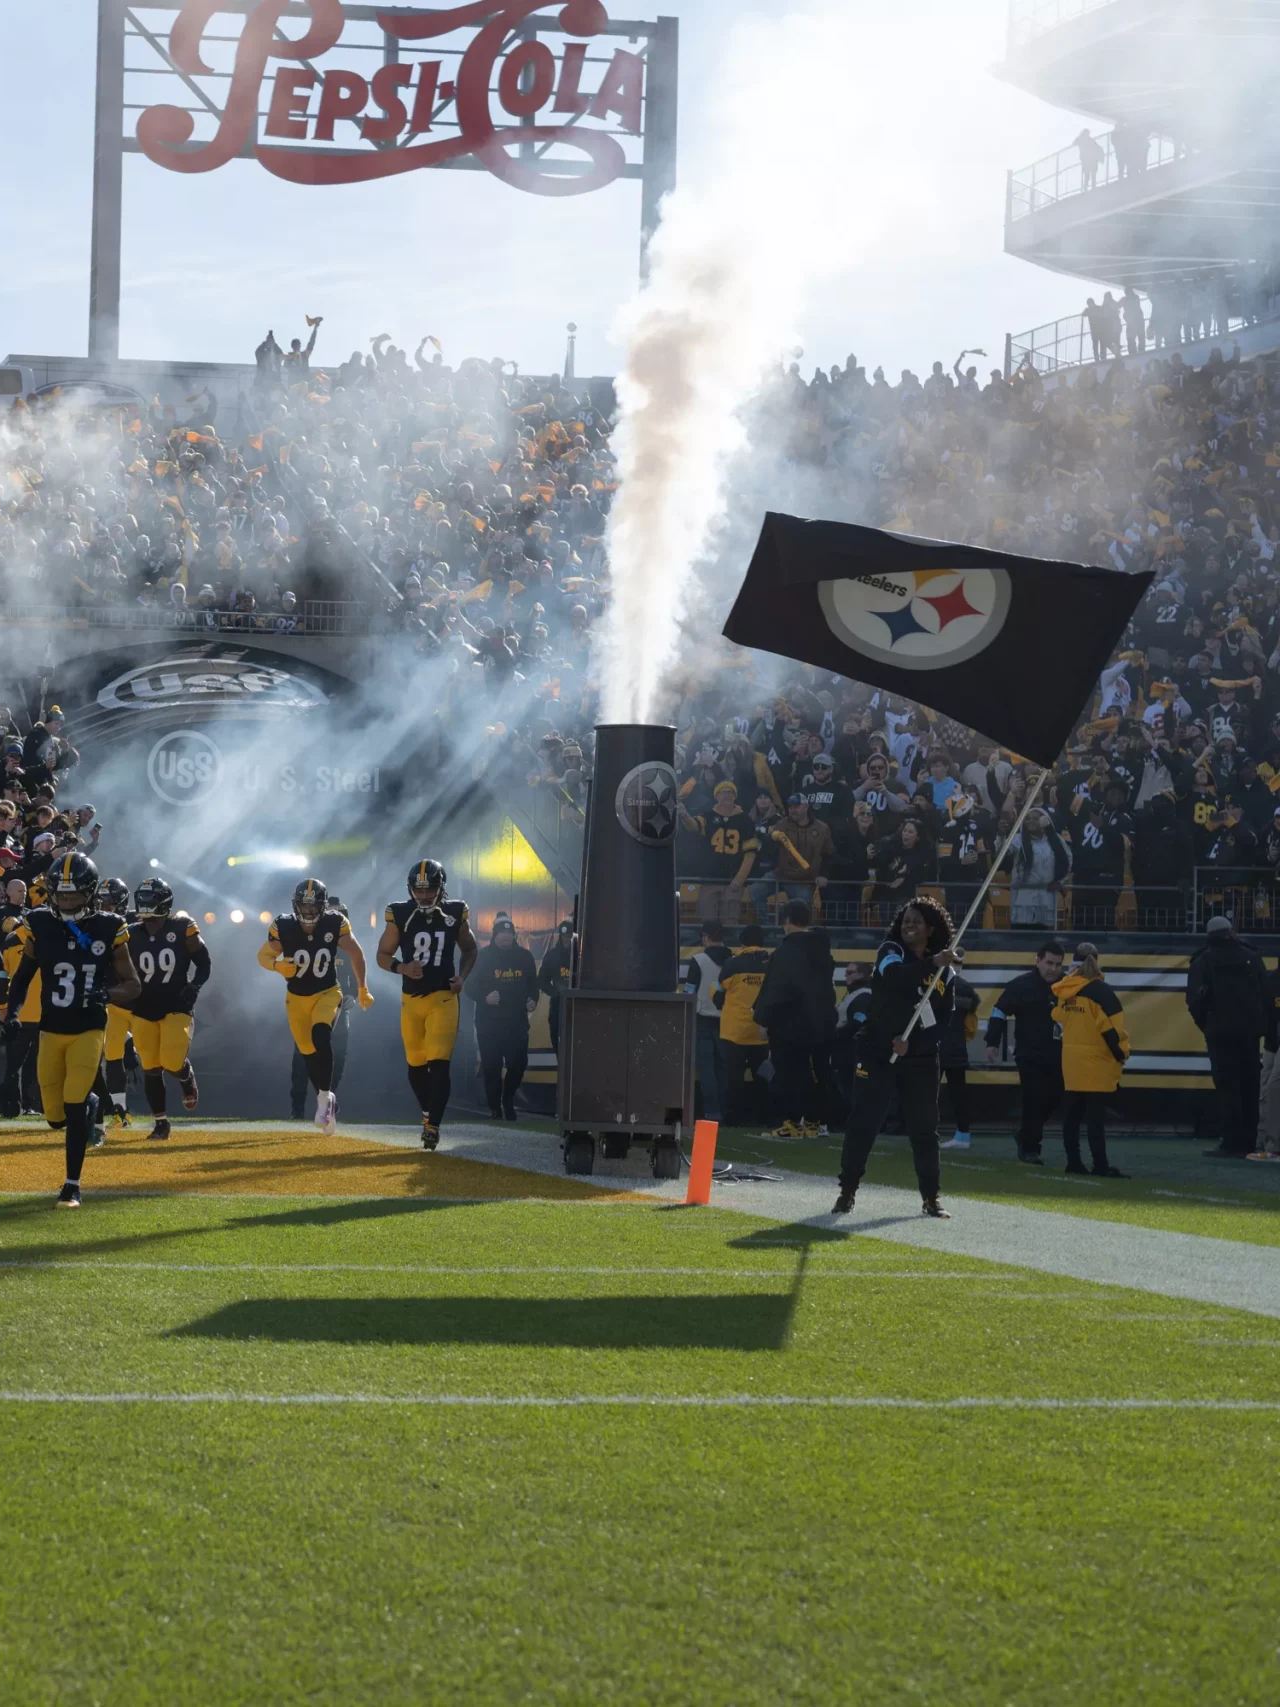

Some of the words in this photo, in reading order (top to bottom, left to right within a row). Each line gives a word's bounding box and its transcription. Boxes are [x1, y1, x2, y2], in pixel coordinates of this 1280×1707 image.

[1155, 605, 1178, 624] 22
[157, 751, 214, 789] USS
[316, 766, 380, 792] Steel
[711, 828, 741, 855] 43
[139, 947, 176, 984] 99
[293, 947, 332, 979] 90
[414, 931, 446, 967] 81
[51, 961, 97, 1008] 31
